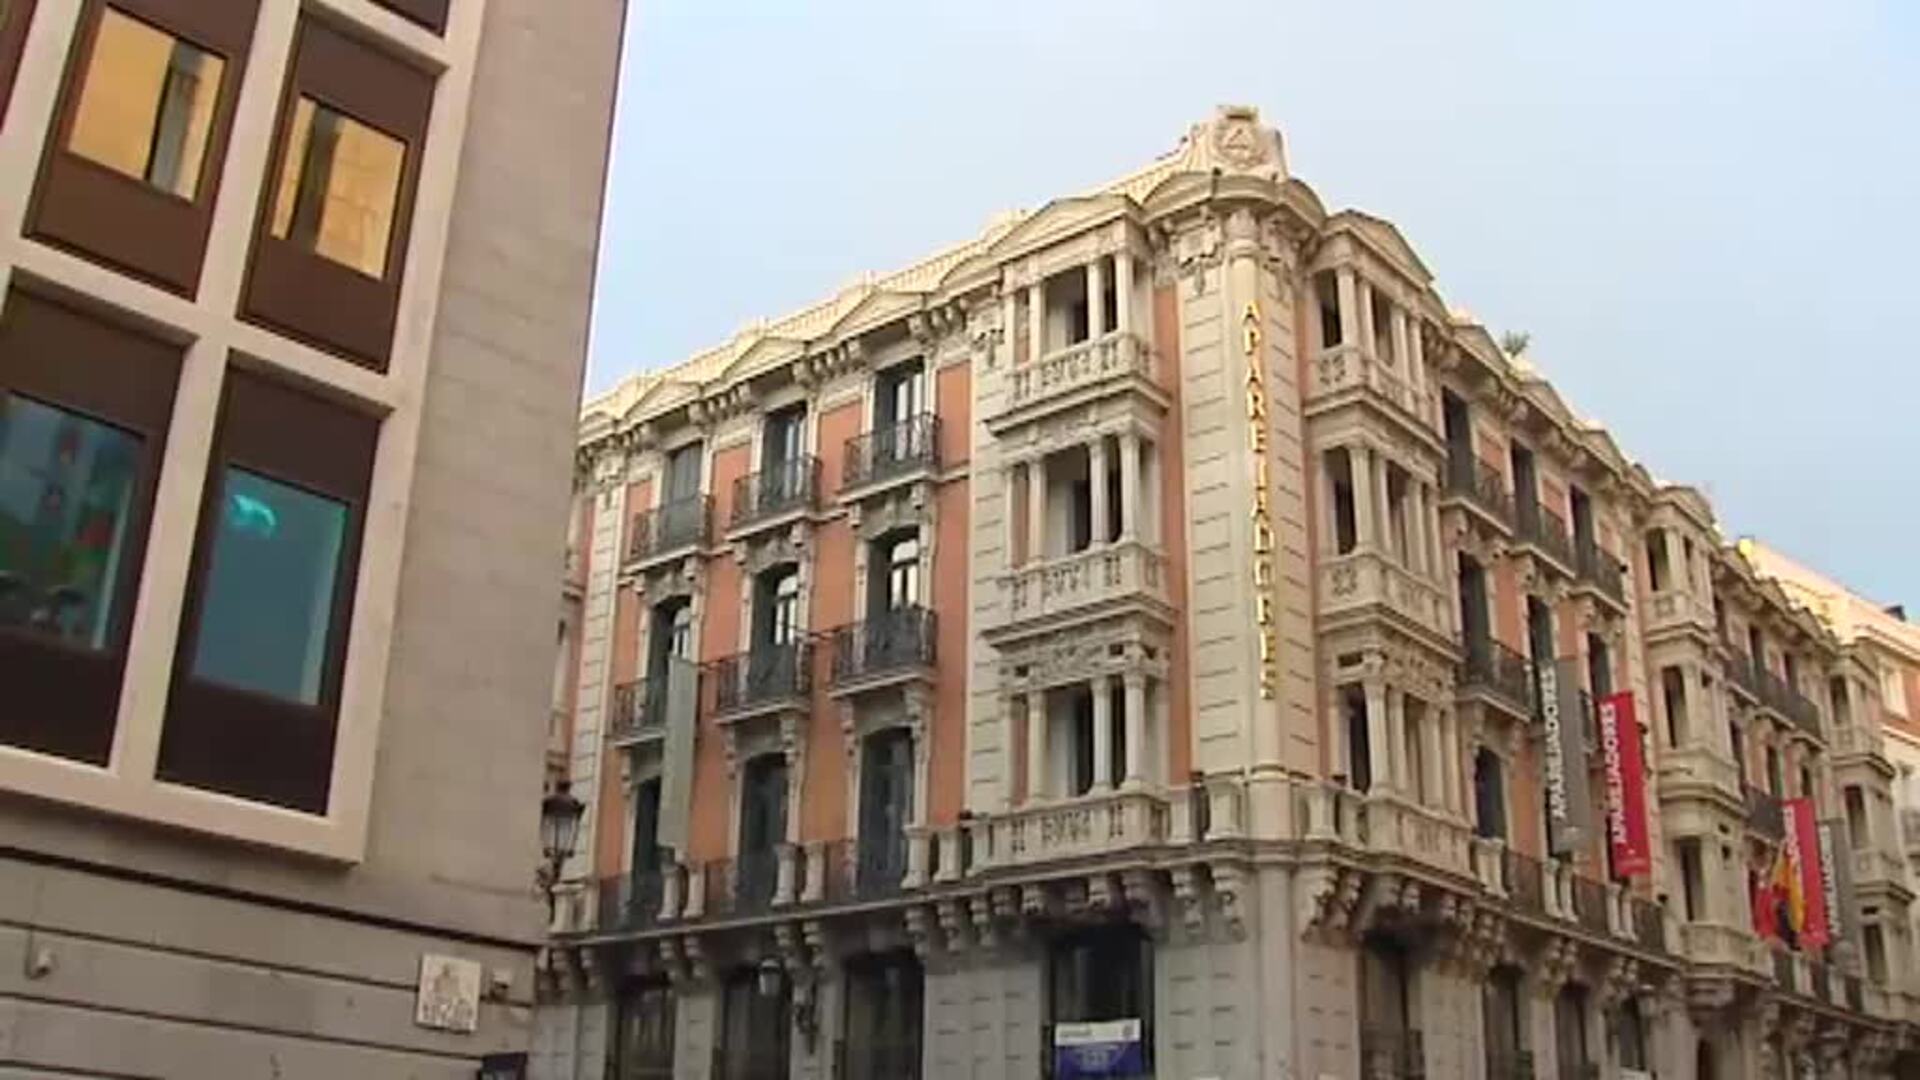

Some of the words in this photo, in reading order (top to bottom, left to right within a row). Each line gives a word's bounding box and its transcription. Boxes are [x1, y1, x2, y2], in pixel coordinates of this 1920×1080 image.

[1243, 304, 1275, 700] APAREJADORES
[1541, 665, 1567, 819] APAREJADORES
[1600, 702, 1627, 844] APAREJADORES
